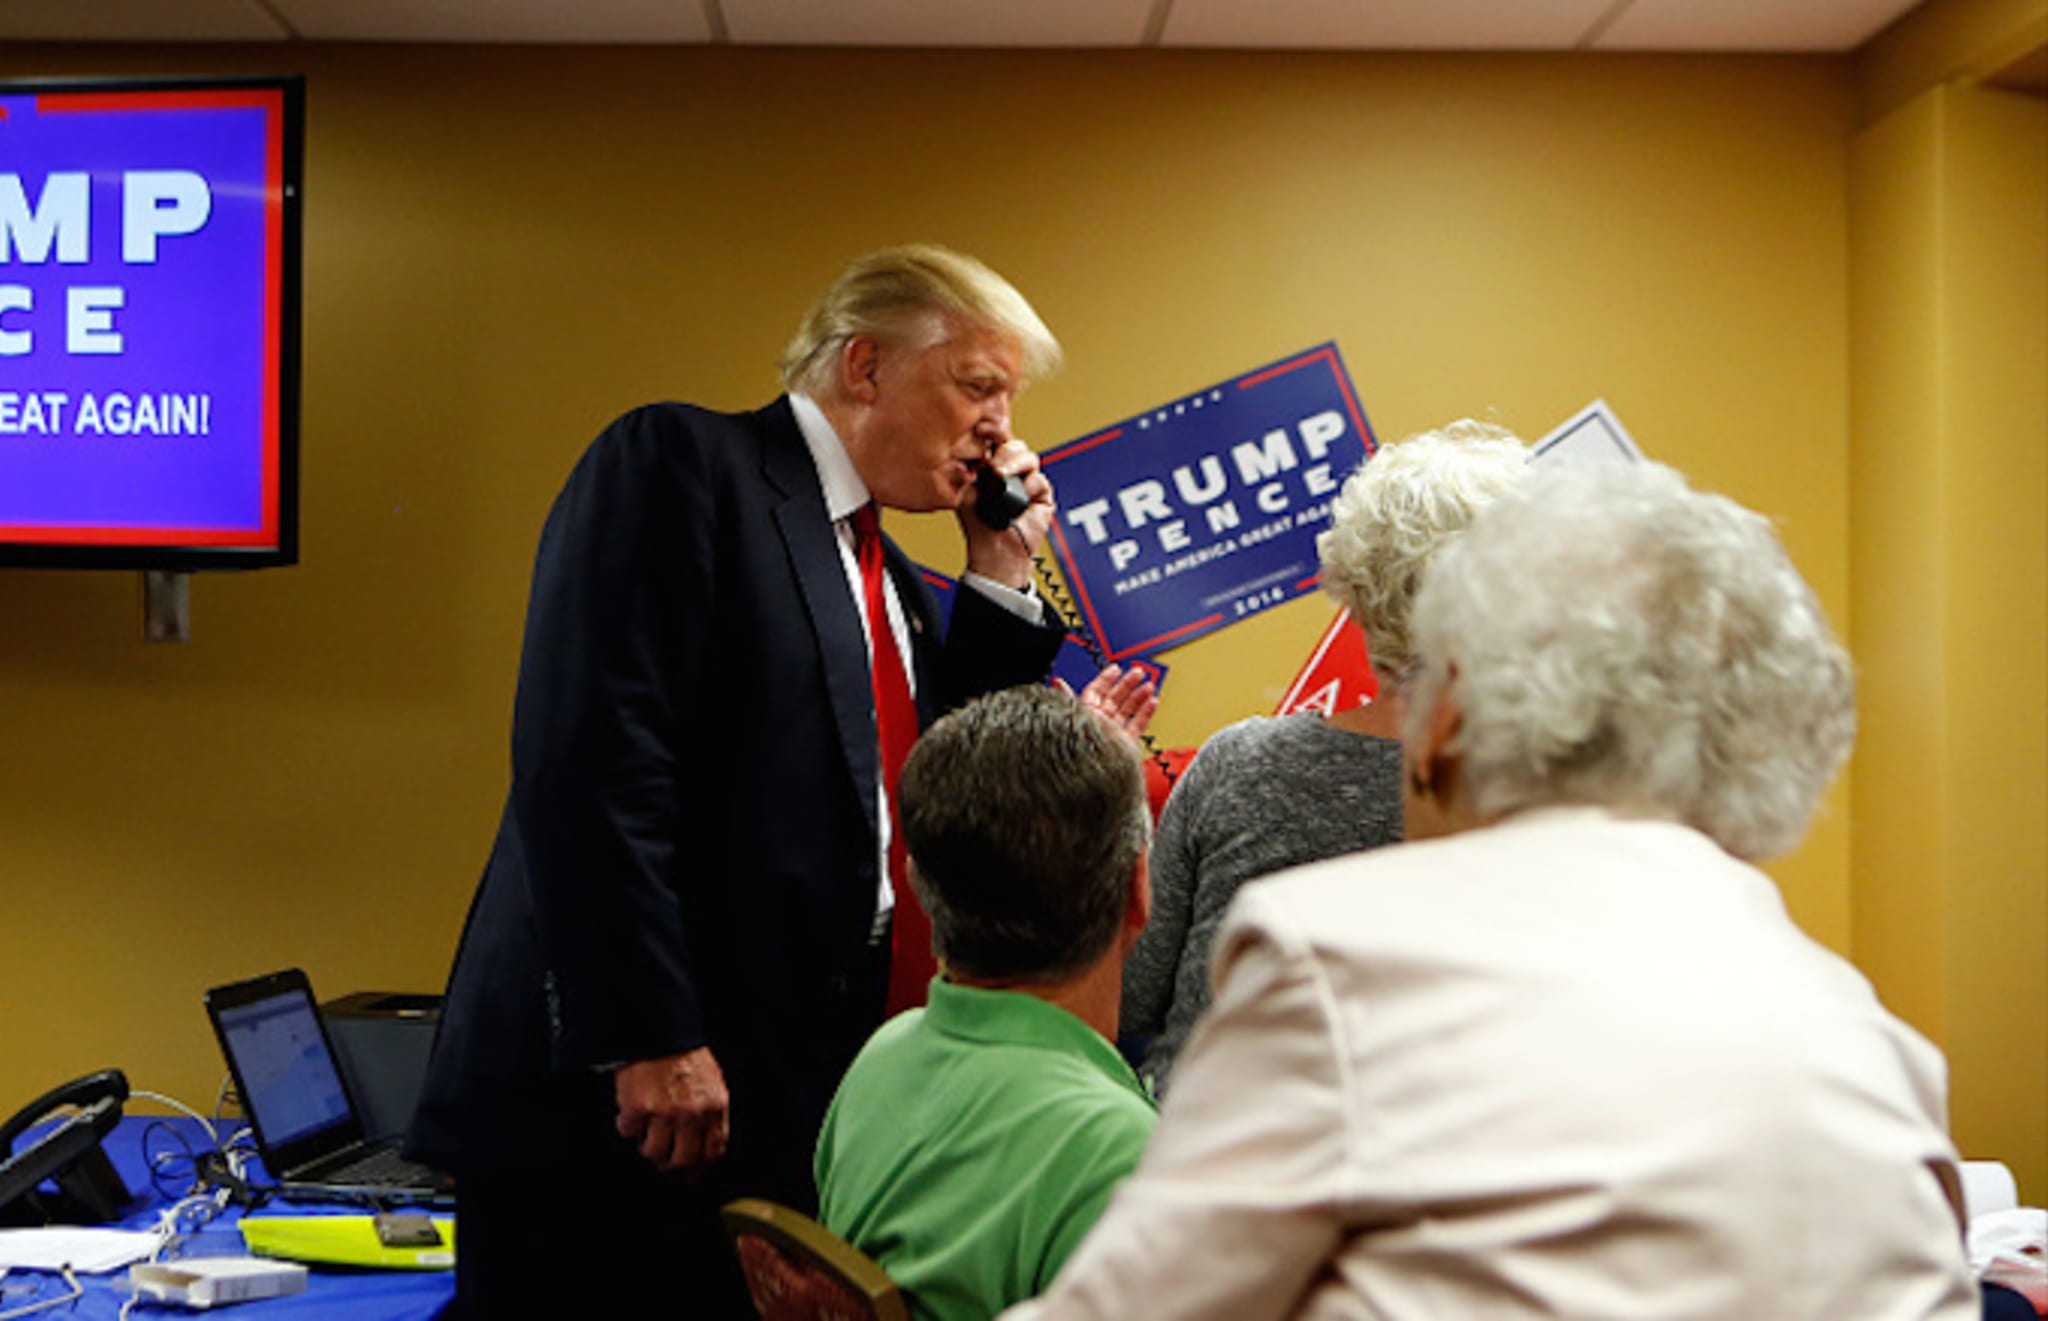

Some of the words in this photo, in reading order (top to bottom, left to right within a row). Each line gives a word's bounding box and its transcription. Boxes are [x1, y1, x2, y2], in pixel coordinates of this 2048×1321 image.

[74, 391, 209, 435] AGAIN!
[1066, 410, 1346, 544] TRUMP
[1108, 463, 1337, 571] PENCE
[1114, 567, 1161, 595] MAKE
[1164, 538, 1237, 576] AMERICA
[1239, 515, 1293, 547] GREAT
[1234, 586, 1284, 616] 2016
